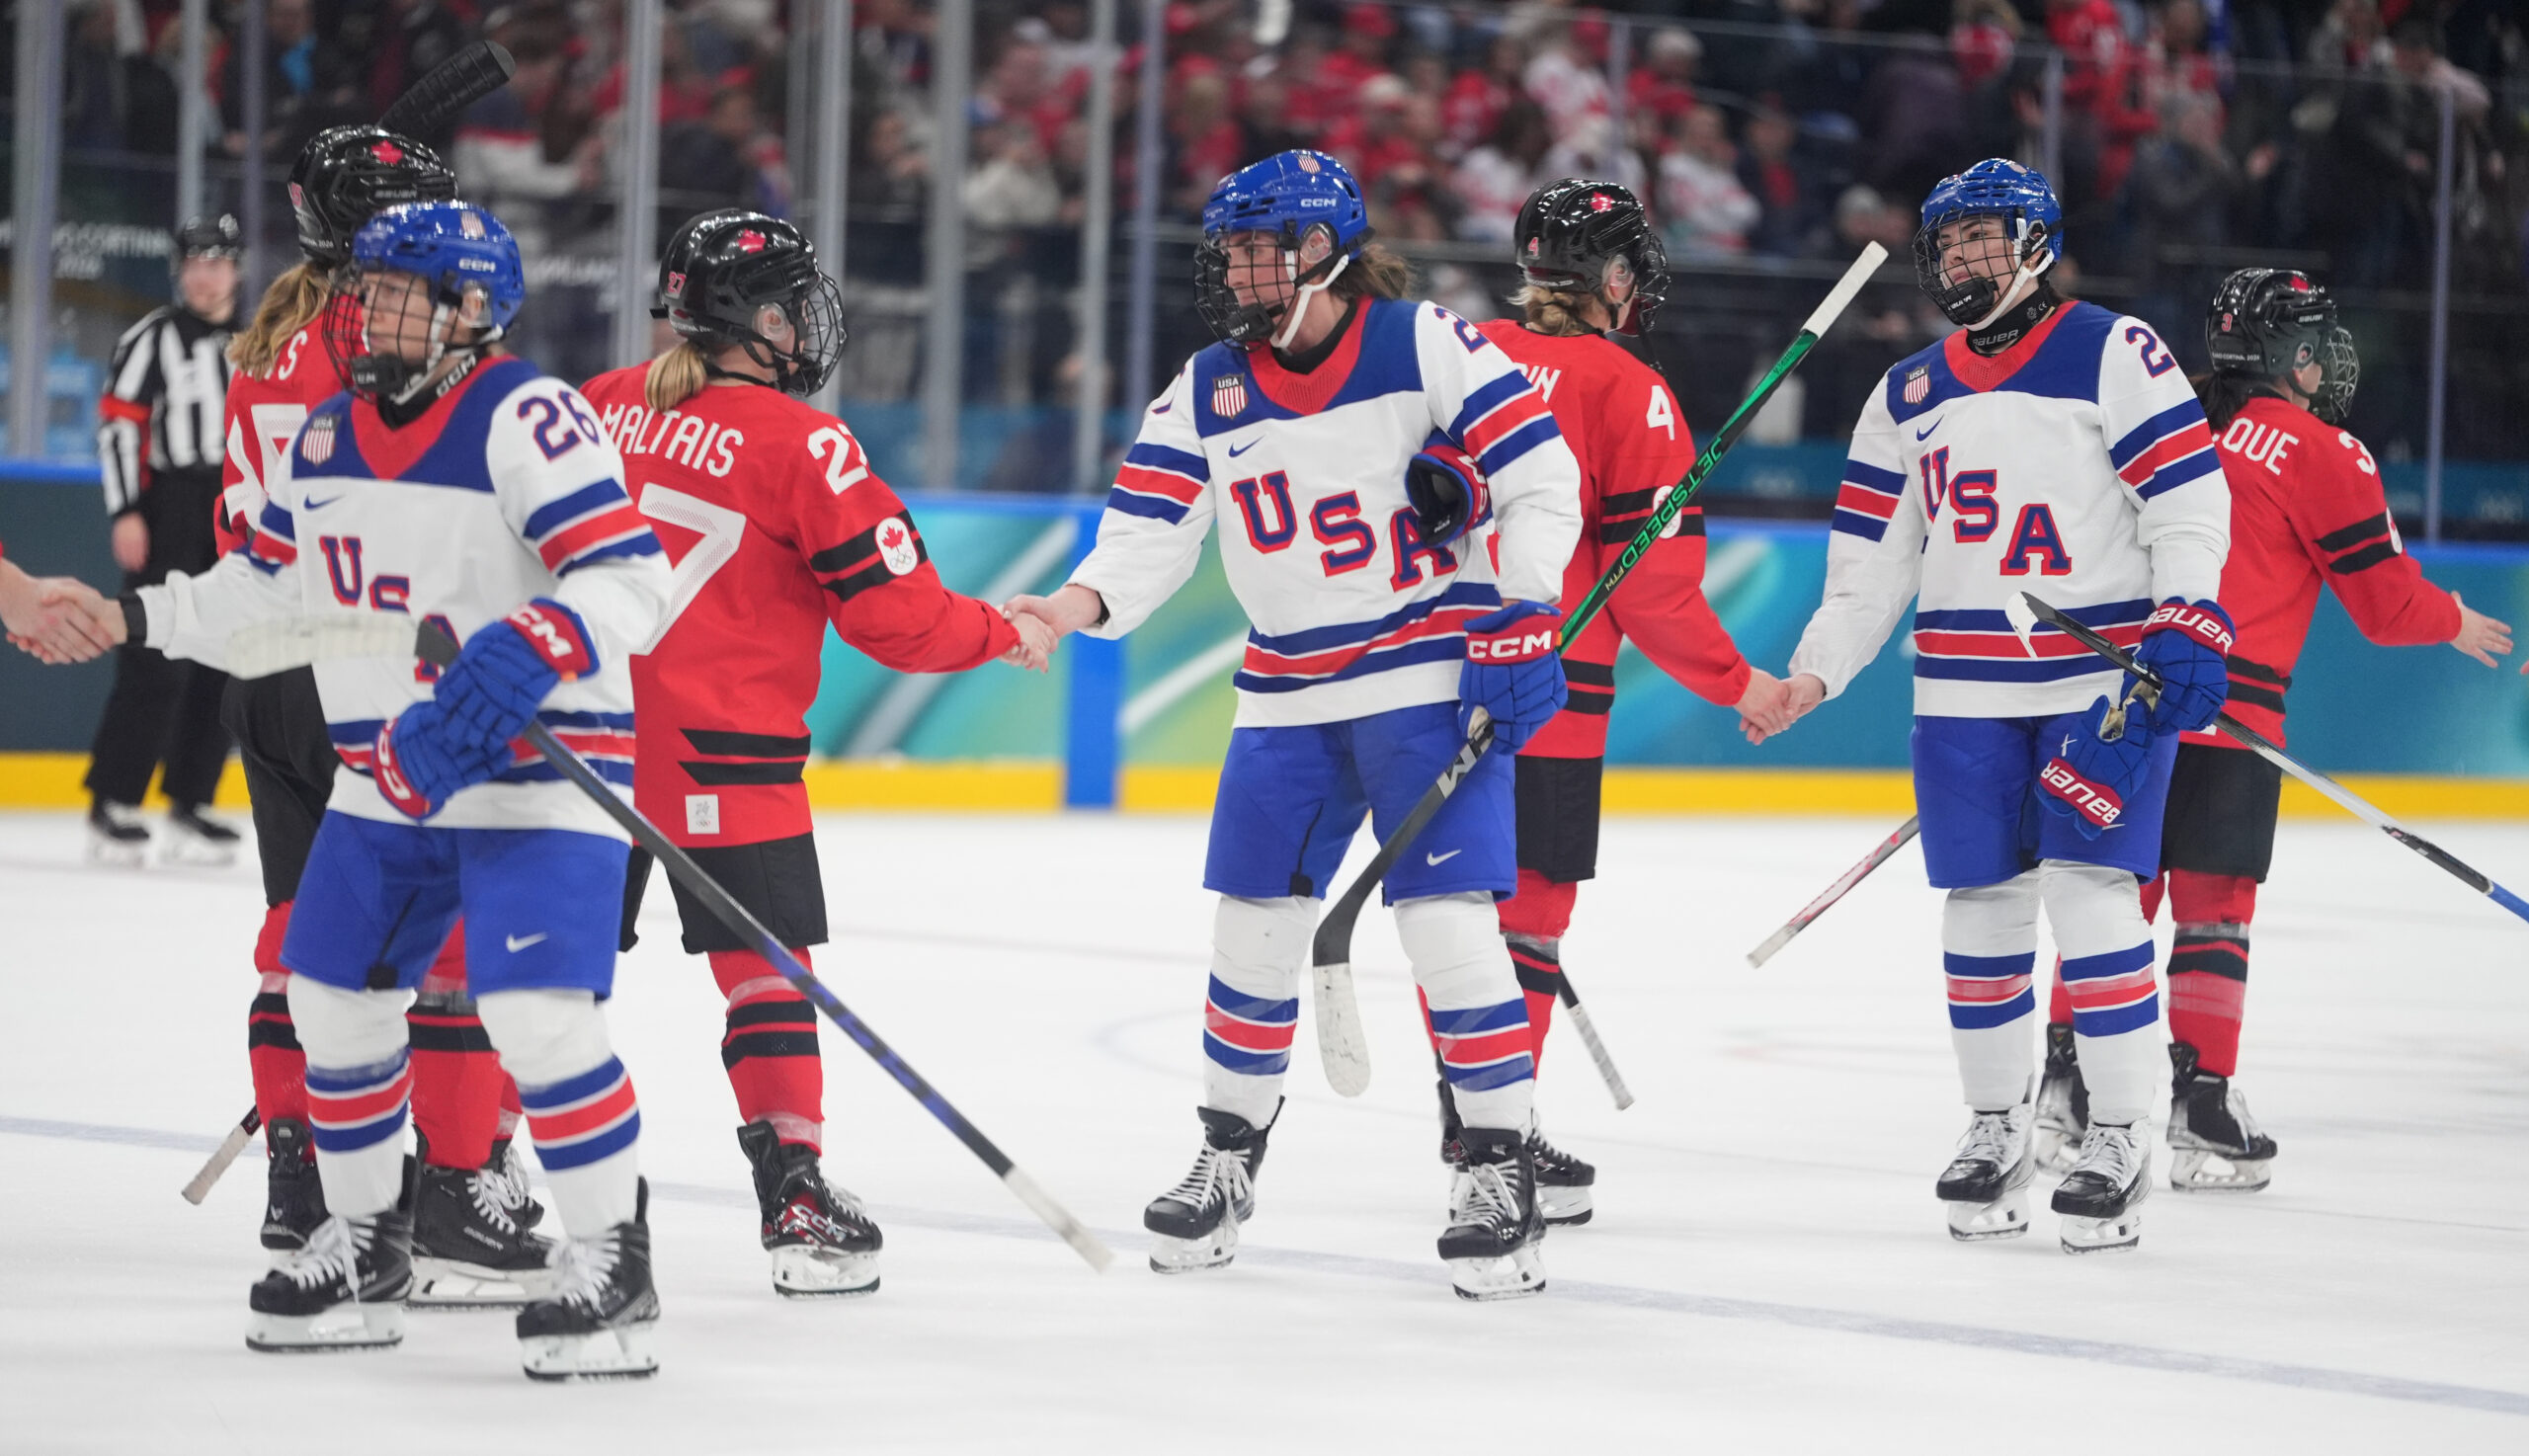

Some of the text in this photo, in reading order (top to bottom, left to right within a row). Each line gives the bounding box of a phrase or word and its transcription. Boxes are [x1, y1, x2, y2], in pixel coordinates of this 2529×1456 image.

[1300, 199, 1337, 208] CCM
[1528, 236, 1539, 257] 4
[668, 271, 687, 294] 27
[2221, 312, 2233, 332] 3
[1218, 377, 1239, 389] USA
[1909, 368, 1925, 382] USA
[313, 416, 334, 430] USA
[517, 390, 601, 463] 26
[1646, 385, 1674, 441] 4
[601, 403, 745, 477] MALTAIS
[2212, 417, 2299, 476] QUE
[2338, 431, 2376, 476] 3
[1621, 436, 1722, 569] JETSPEED
[1919, 445, 2072, 576] USA
[1229, 469, 1459, 594] USA
[1468, 630, 1552, 660] CCM
[2040, 761, 2121, 825] BAUER
